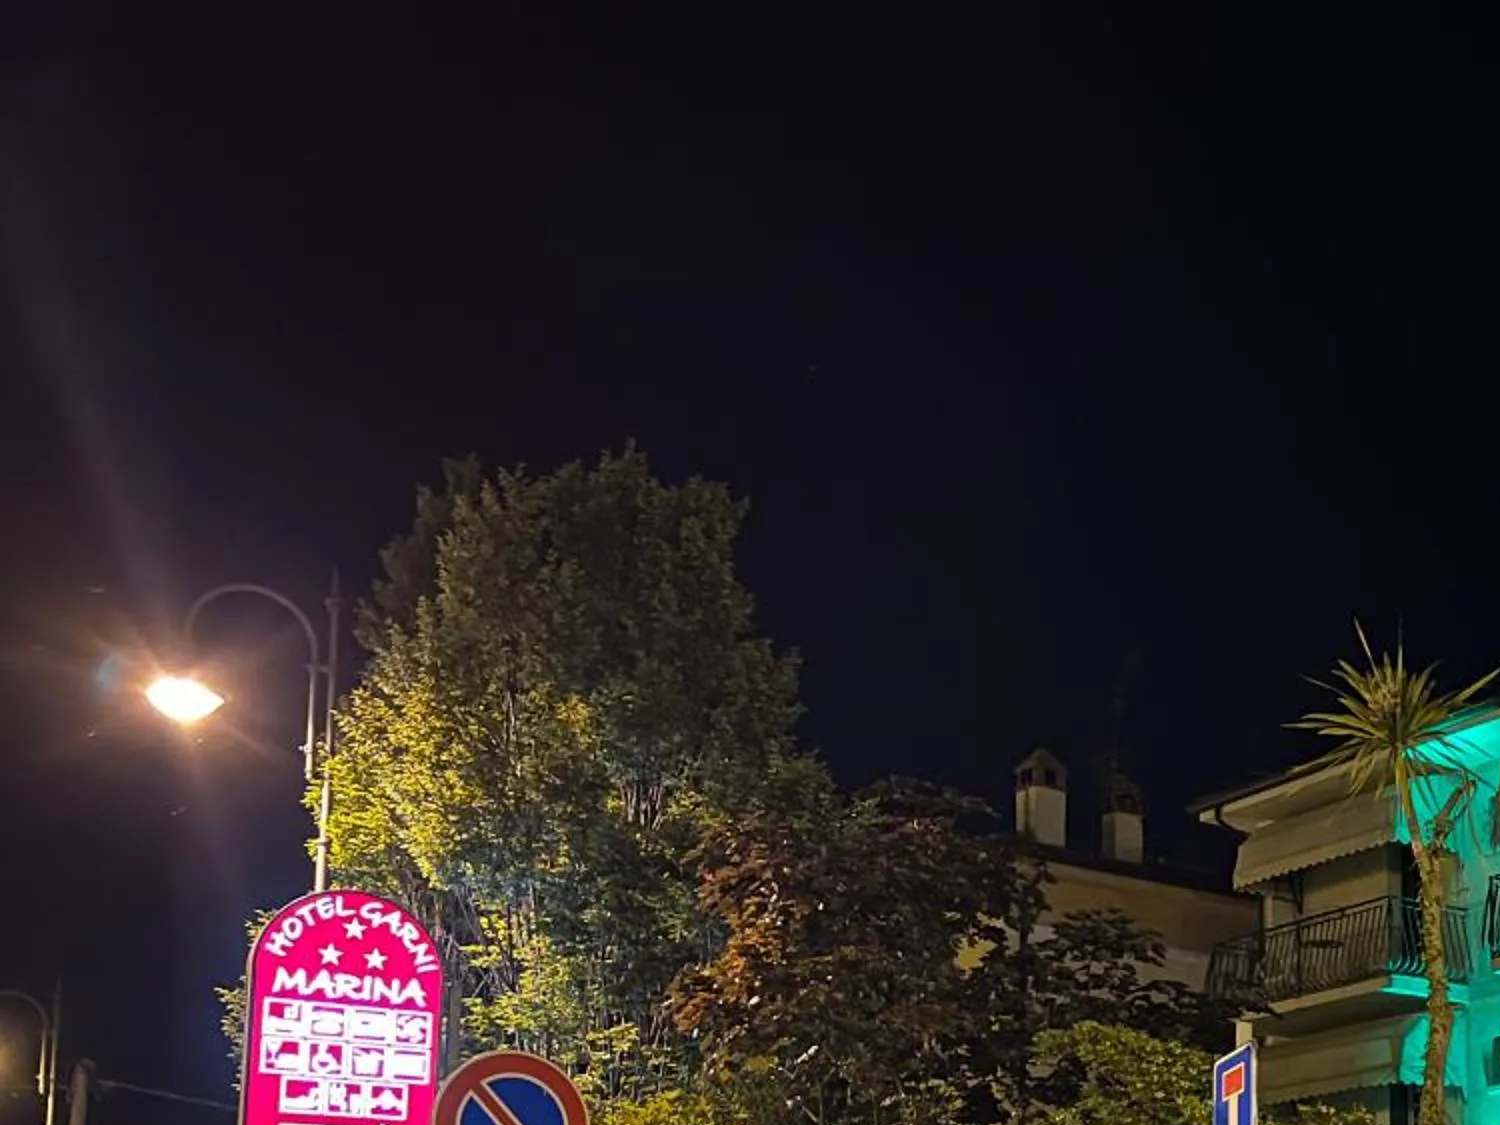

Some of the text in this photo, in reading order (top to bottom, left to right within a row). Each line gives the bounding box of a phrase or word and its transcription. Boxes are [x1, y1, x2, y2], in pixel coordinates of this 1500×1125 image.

[264, 895, 439, 974] HOTEL GARNI
[271, 968, 427, 1008] MARINA
